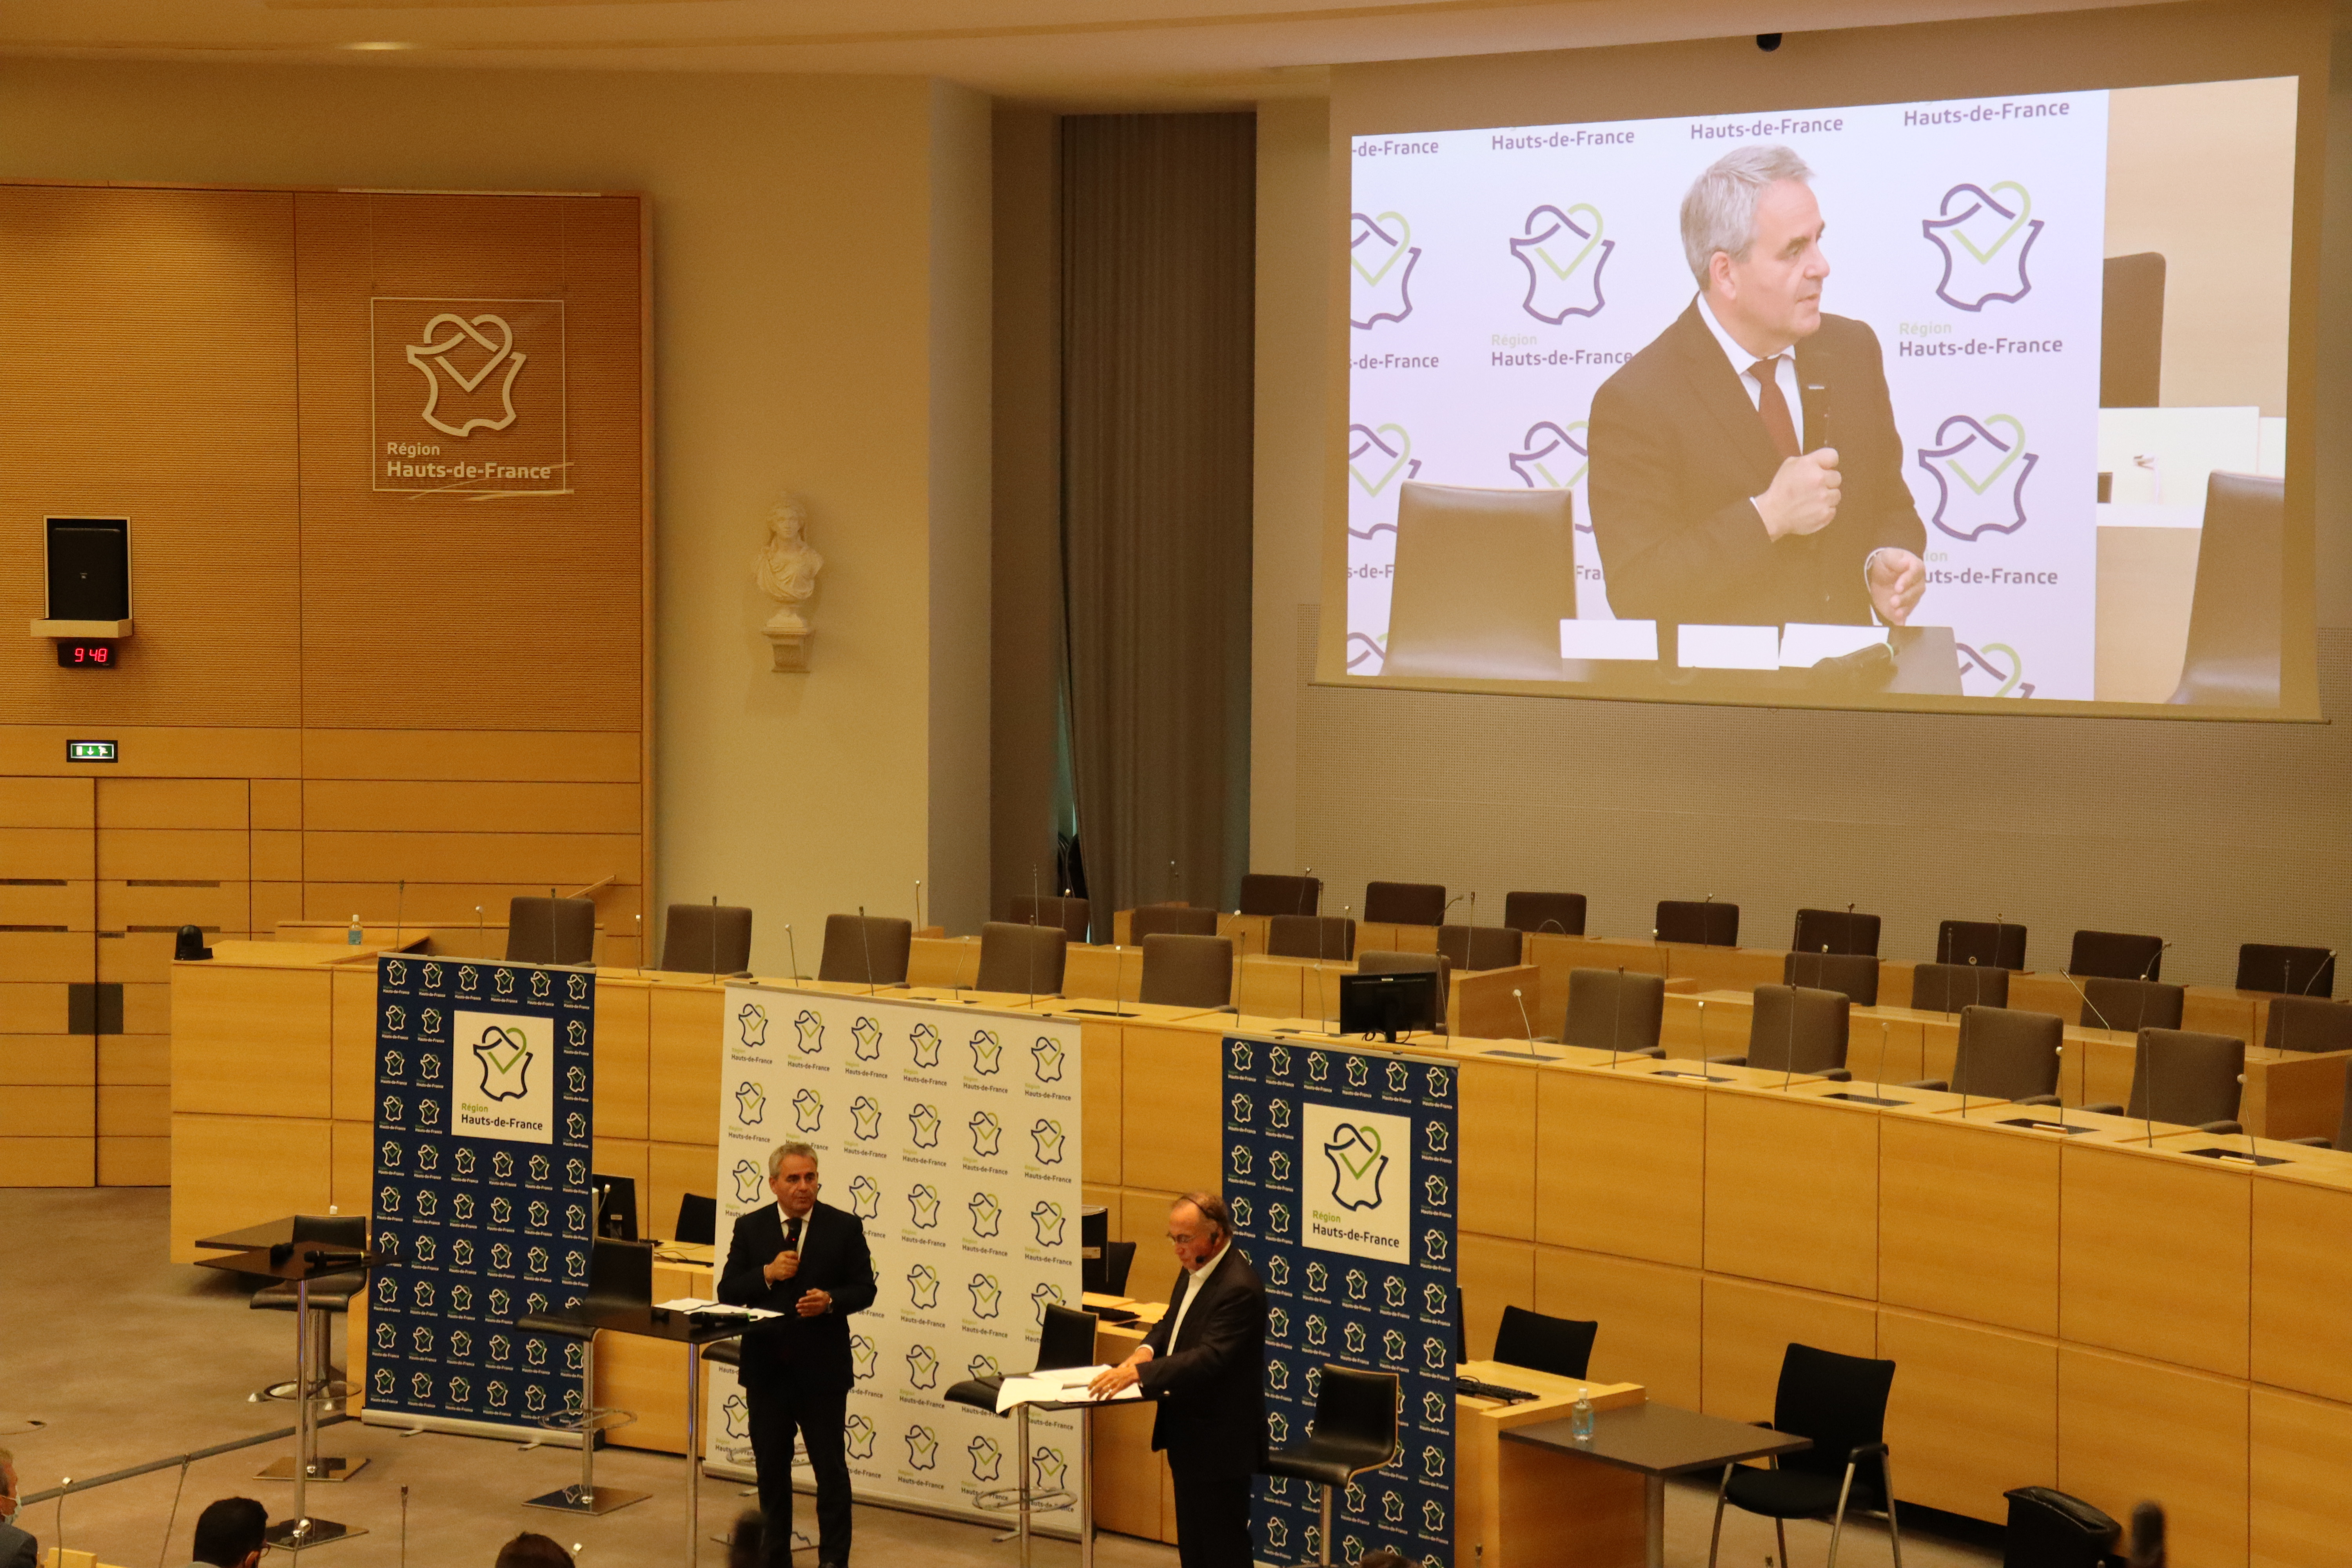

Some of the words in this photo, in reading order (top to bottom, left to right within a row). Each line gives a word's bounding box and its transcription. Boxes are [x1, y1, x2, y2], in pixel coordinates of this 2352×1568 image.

[1904, 101, 2070, 126] Hauts-de-France
[1691, 118, 1843, 140] Hauts-de-France
[1492, 130, 1635, 151] Hauts-de-France
[1352, 140, 1439, 157] -de-France
[1900, 323, 1952, 337] Région
[1492, 334, 1537, 348] Région
[1900, 338, 2062, 357] Hauts-de-France
[1351, 354, 1439, 369] -de-France
[1492, 350, 1632, 367] Hauts-de-France
[387, 441, 440, 458] Région
[387, 461, 551, 479] Hauts-de-France
[1925, 568, 2057, 584] uts-de-France
[74, 648, 84, 662] 9
[89, 648, 108, 662] 48
[732, 1054, 772, 1063] Hauts-de-France
[788, 1062, 829, 1071] Hauts-de-France
[846, 1069, 887, 1078] Hauts-de-France
[904, 1076, 947, 1085] Hauts-de-France
[964, 1083, 1007, 1093] Hauts-de-France
[1025, 1091, 1071, 1100] Hauts-de-France
[461, 1103, 488, 1114] Région
[461, 1114, 543, 1131] Hauts-de-France
[729, 1132, 769, 1142] Hauts-de-France
[844, 1148, 886, 1158] Hauts-de-France
[903, 1156, 946, 1166] Hauts-de-France
[963, 1164, 1007, 1174] Hauts-de-France
[1025, 1172, 1071, 1183] Hauts-de-France
[1312, 1210, 1341, 1223] Région
[1313, 1223, 1399, 1248] Hauts-de-France
[902, 1236, 946, 1247] Hauts-de-France
[963, 1245, 1007, 1256] Hauts-de-France
[1025, 1254, 1072, 1265] Hauts-de-France
[901, 1316, 945, 1327] Hauts-de-France
[962, 1326, 1007, 1338] Hauts-de-France
[900, 1397, 944, 1407] Hauts-de-France
[848, 1468, 881, 1479] s-de-France
[898, 1477, 943, 1488] Hauts-de-France
